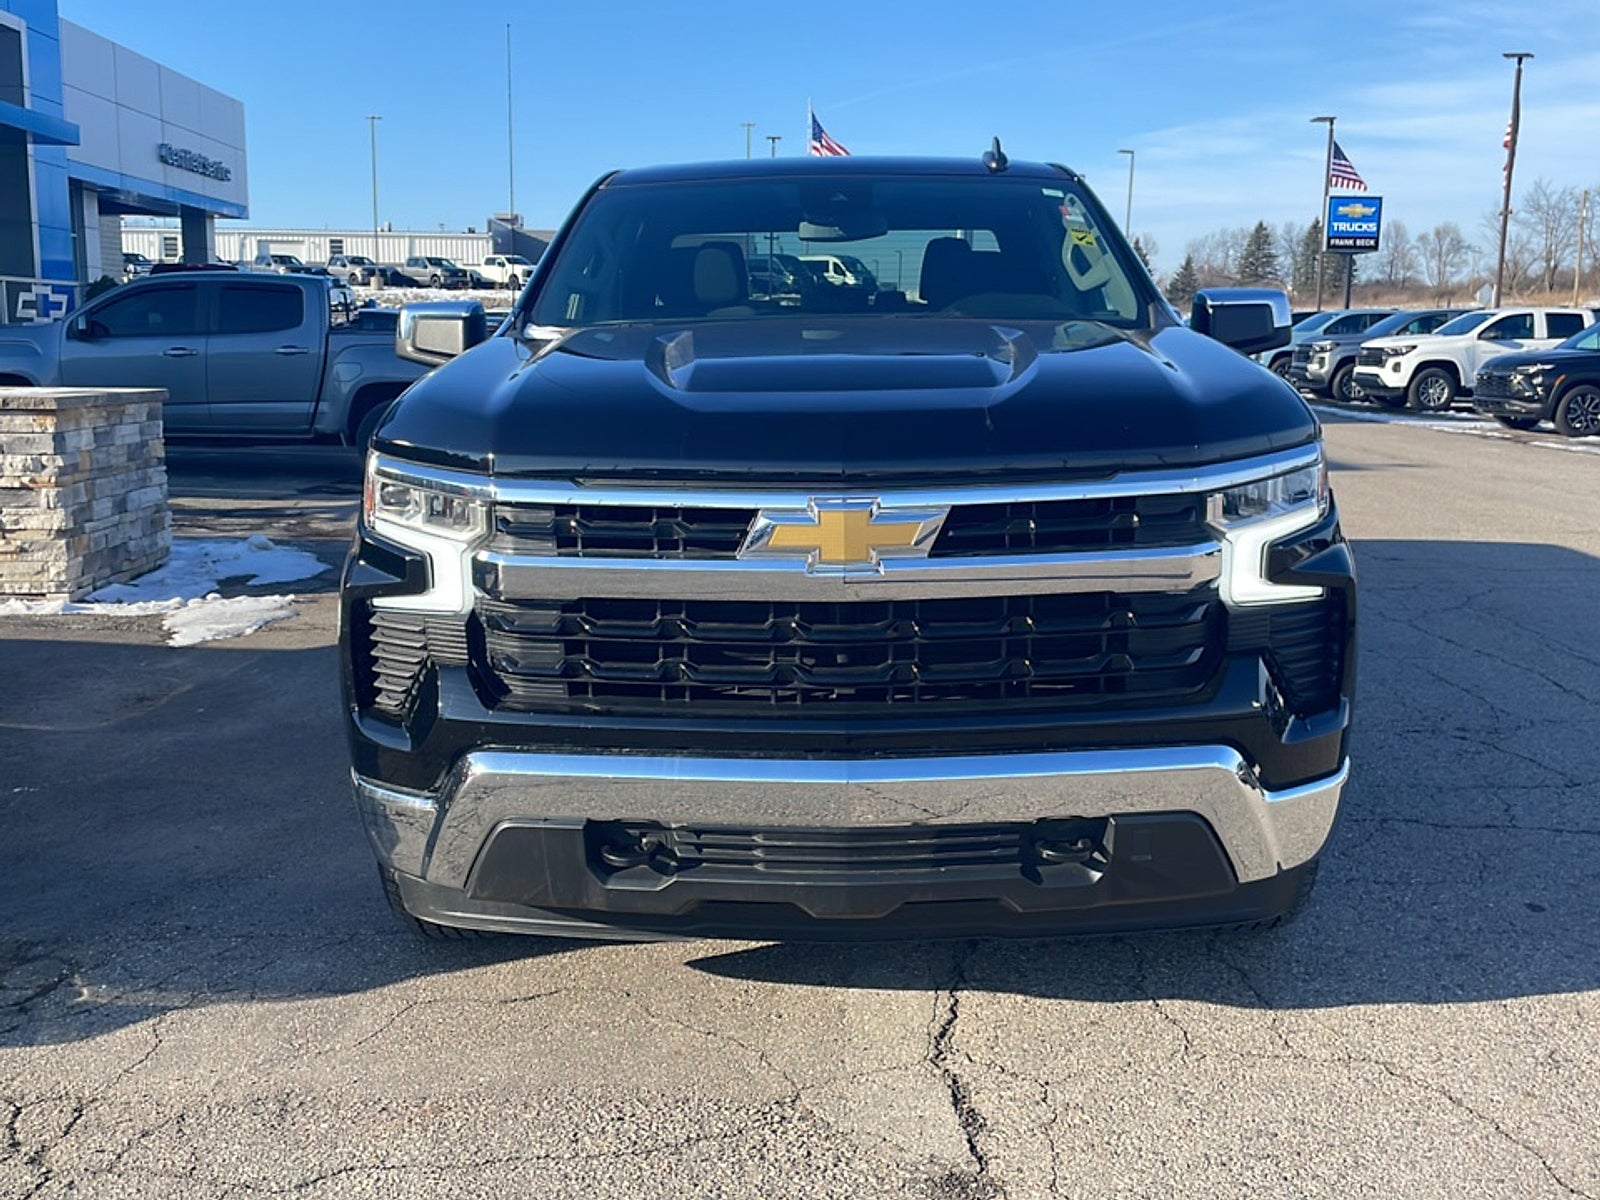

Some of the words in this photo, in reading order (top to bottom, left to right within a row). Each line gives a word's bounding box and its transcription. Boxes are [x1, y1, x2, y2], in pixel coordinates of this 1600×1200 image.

[1332, 221, 1377, 232] TRUCKS
[1330, 238, 1354, 246] FRANK
[1356, 238, 1375, 246] BECK
